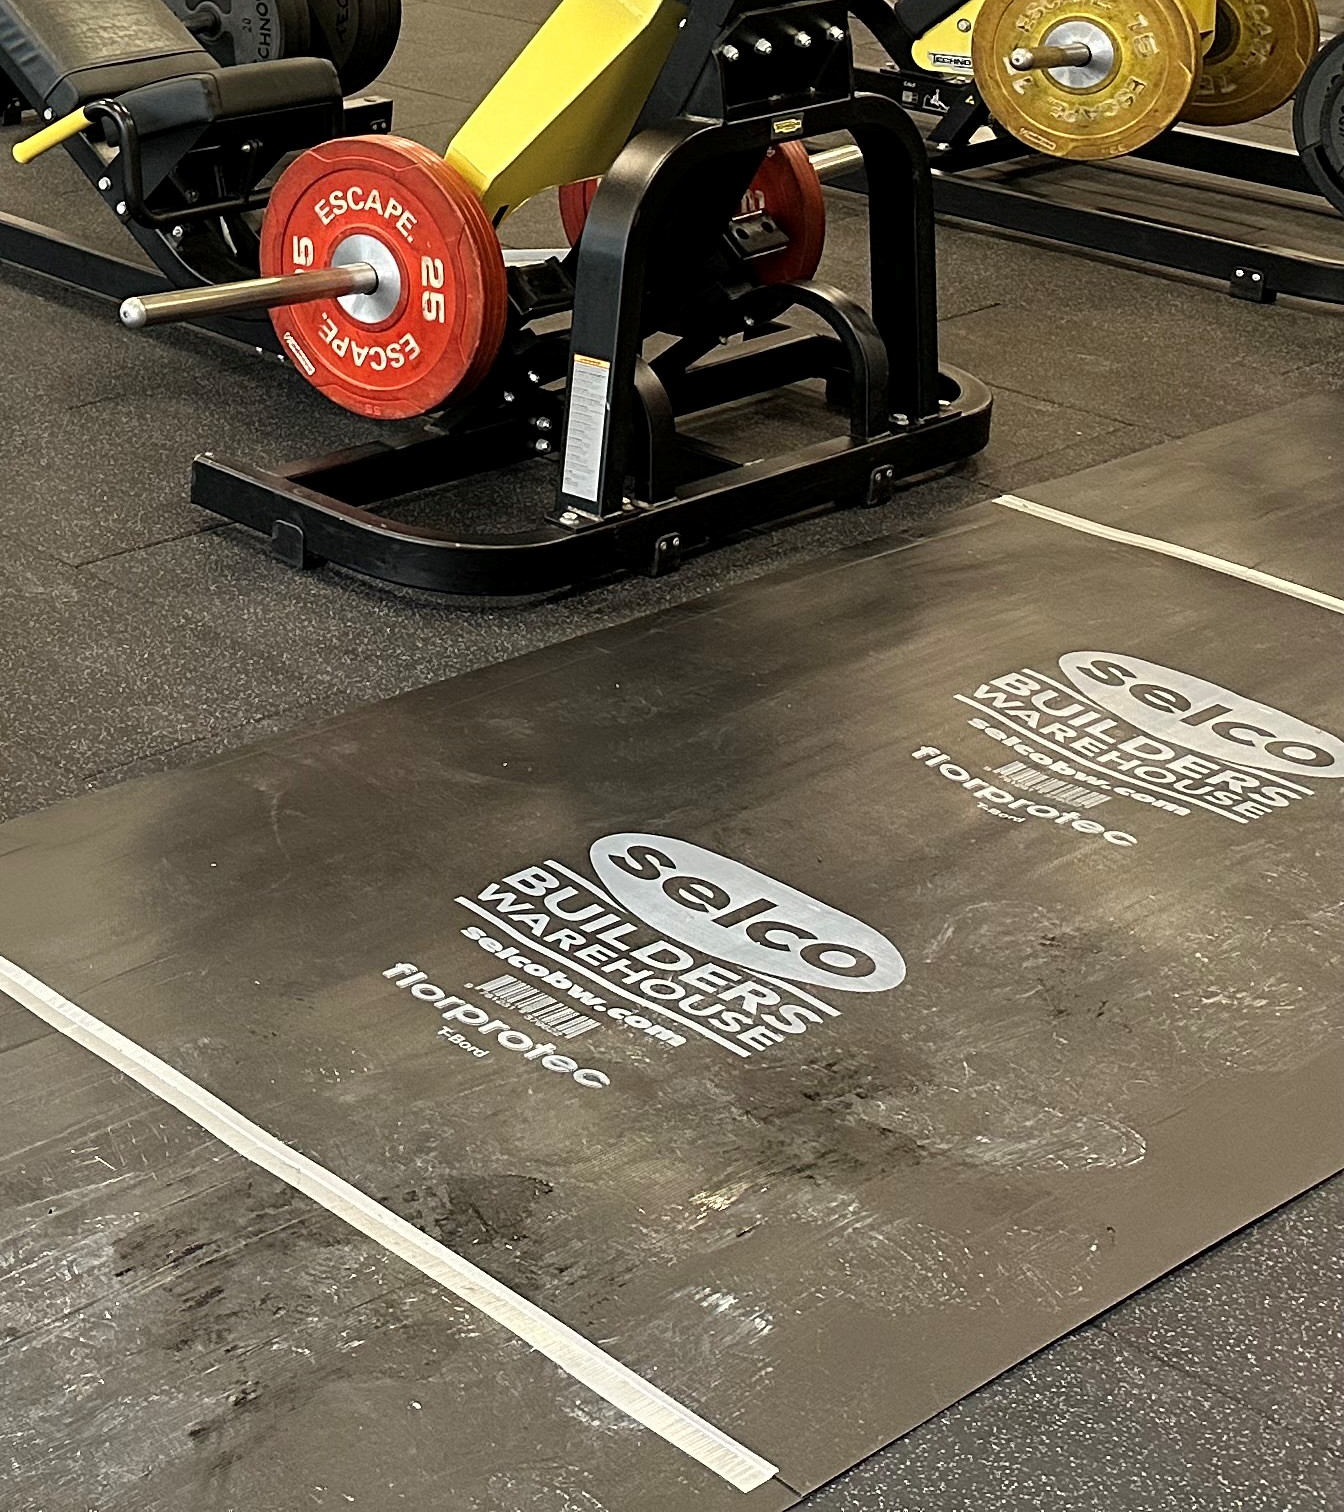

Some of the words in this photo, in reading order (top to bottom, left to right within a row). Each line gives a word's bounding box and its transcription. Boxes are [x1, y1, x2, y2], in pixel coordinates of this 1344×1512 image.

[242, 17, 253, 33] 20
[928, 52, 972, 65] TECHNO
[292, 235, 315, 274] 5
[420, 255, 446, 324] 25
[967, 717, 1192, 817] selcobw.com
[972, 683, 1274, 820] WAREHOUSE
[988, 672, 1303, 808] BUILDERS
[1075, 659, 1336, 768] selco
[911, 745, 1138, 848] florprotec
[501, 865, 825, 1036] BUILDERS
[607, 844, 877, 978] selco
[460, 925, 688, 1048] selcobw.com
[477, 882, 786, 1053] WAREHOUSE
[382, 962, 611, 1089] florprotec
[437, 1025, 490, 1058] T-Bord
